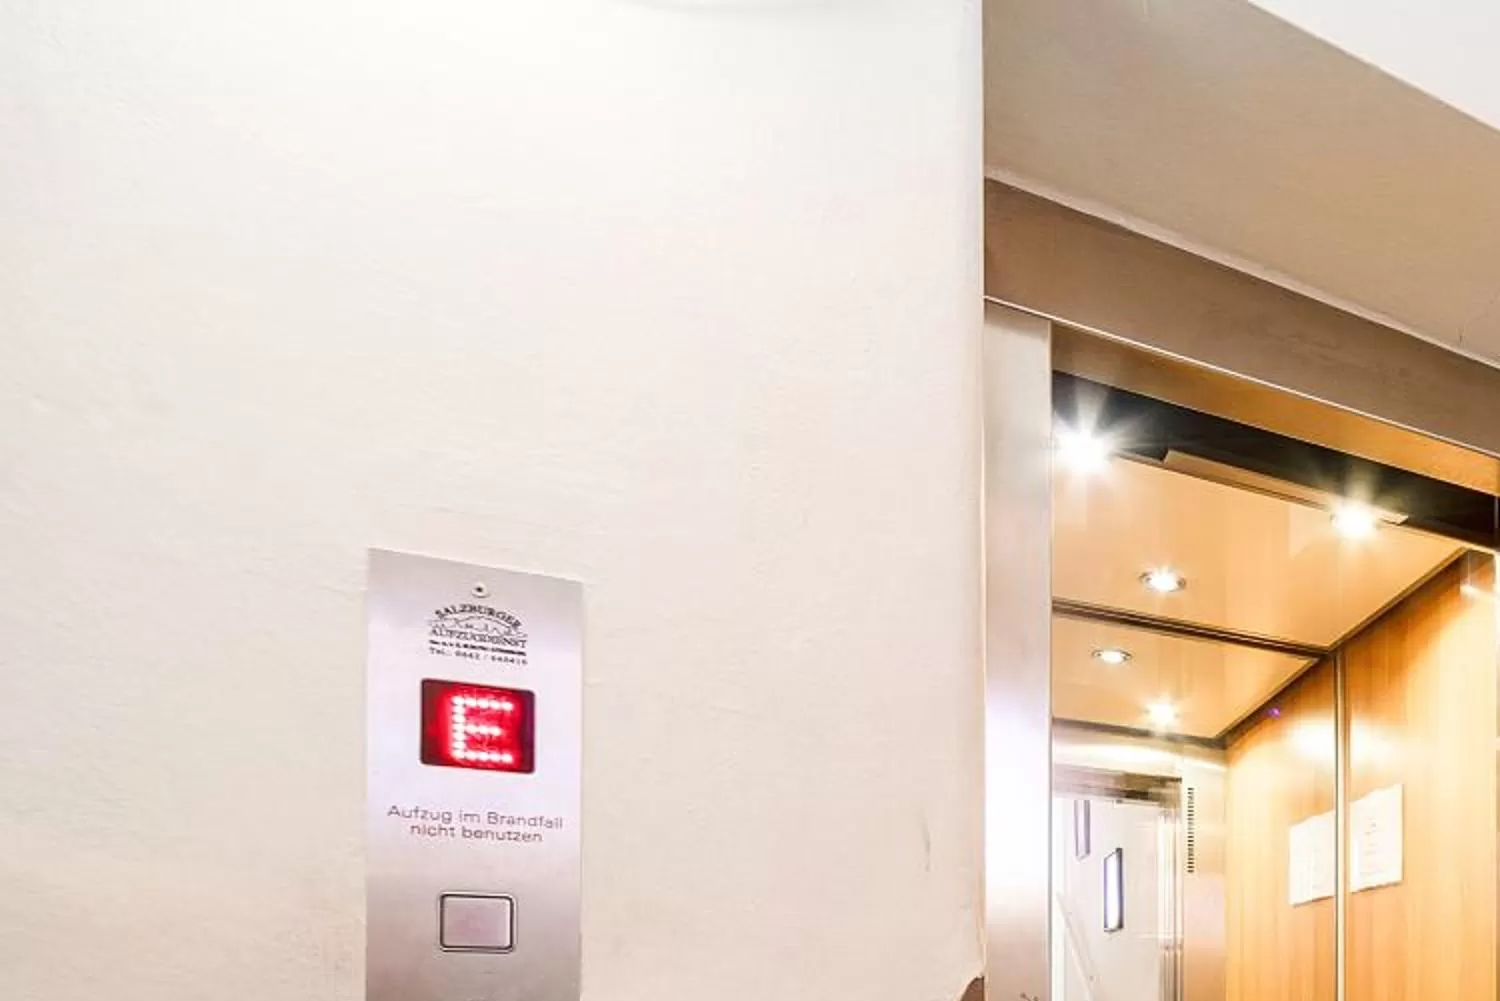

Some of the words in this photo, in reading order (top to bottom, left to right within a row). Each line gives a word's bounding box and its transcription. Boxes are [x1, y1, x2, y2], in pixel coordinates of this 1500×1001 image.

[434, 603, 522, 630] SALZBURGER
[451, 696, 514, 764] E
[387, 804, 452, 823] Aufzug
[459, 809, 481, 823] im
[487, 811, 563, 829] Brandfall
[410, 823, 456, 838] nicht
[462, 826, 543, 842] benutzen
